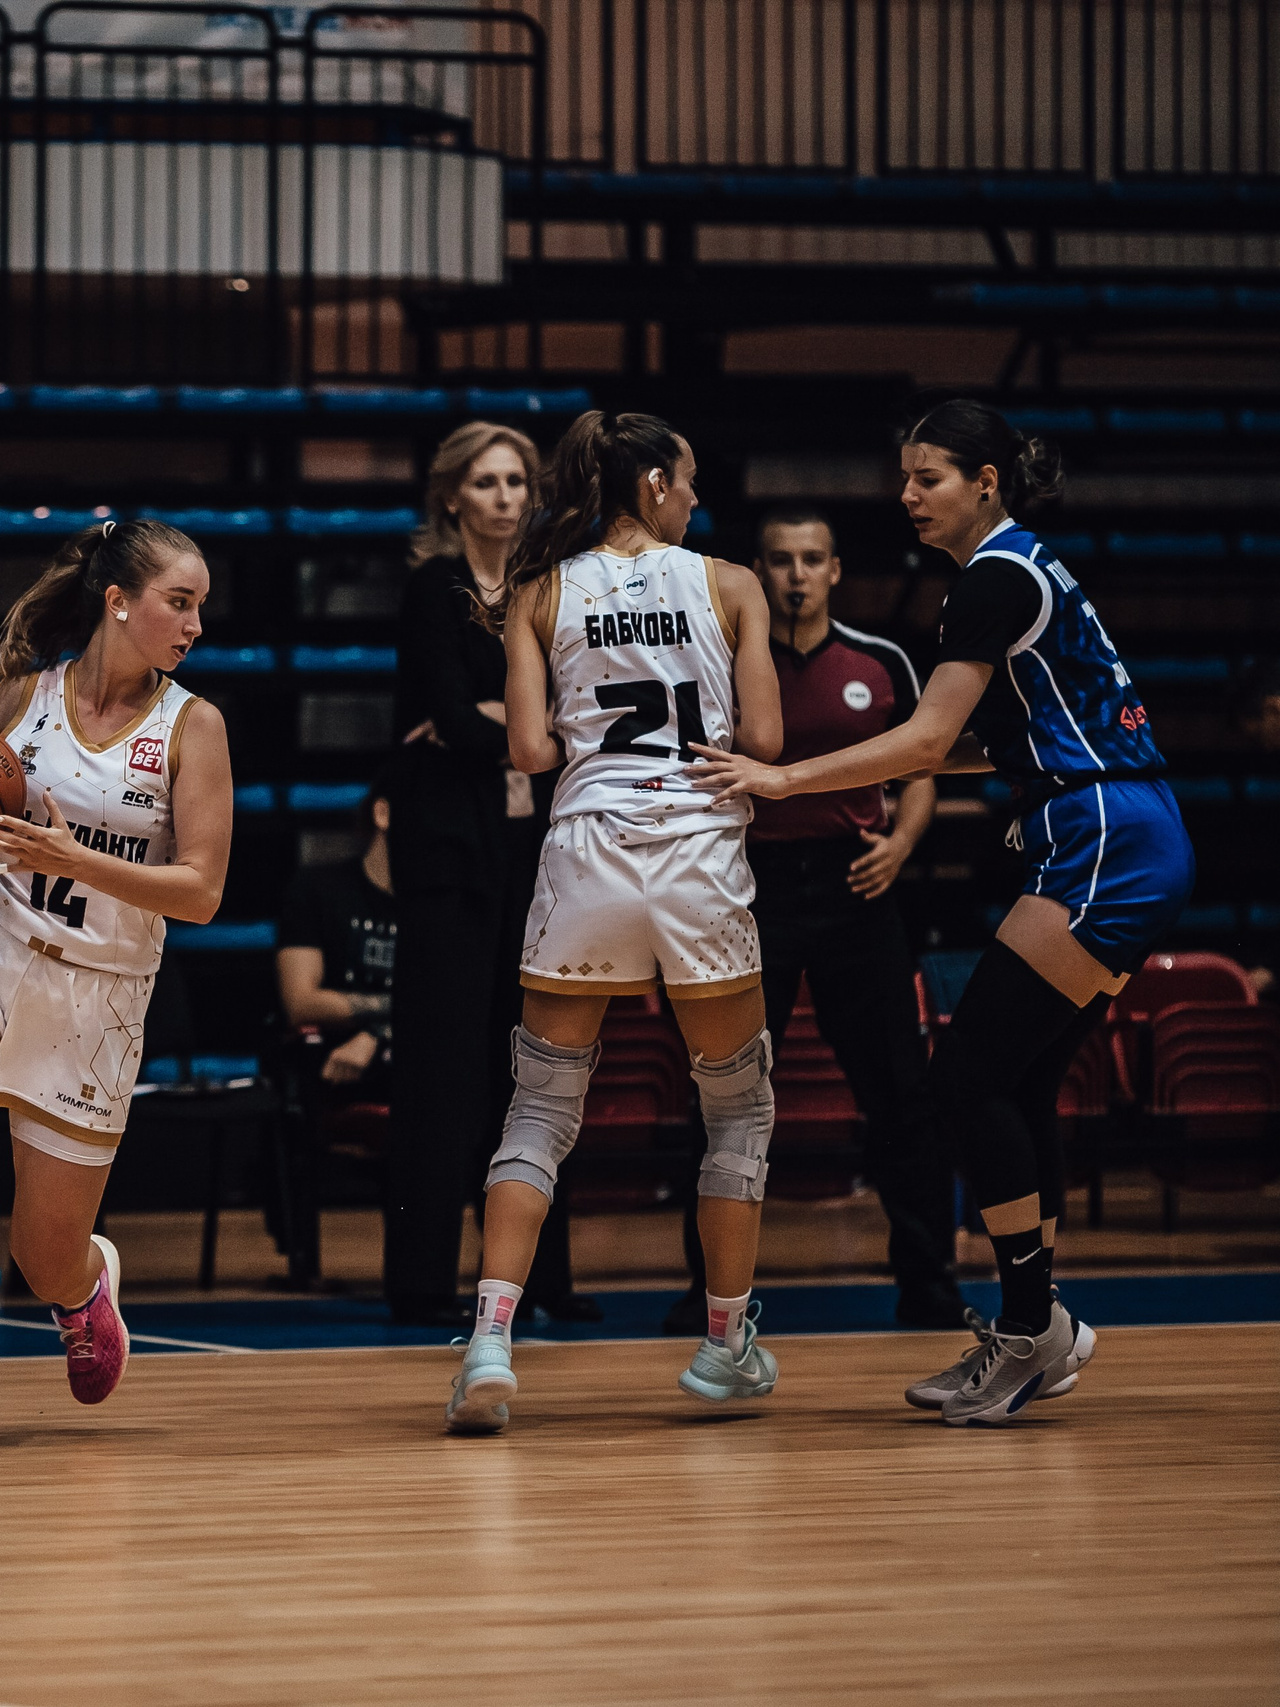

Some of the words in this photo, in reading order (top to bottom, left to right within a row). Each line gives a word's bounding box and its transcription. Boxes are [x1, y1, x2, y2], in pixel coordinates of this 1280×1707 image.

[585, 610, 692, 649] БАБКОВА
[594, 679, 709, 762] 21
[131, 752, 163, 769] BET
[30, 871, 87, 928] 14
[55, 1091, 112, 1117] ХИМПРОМ
